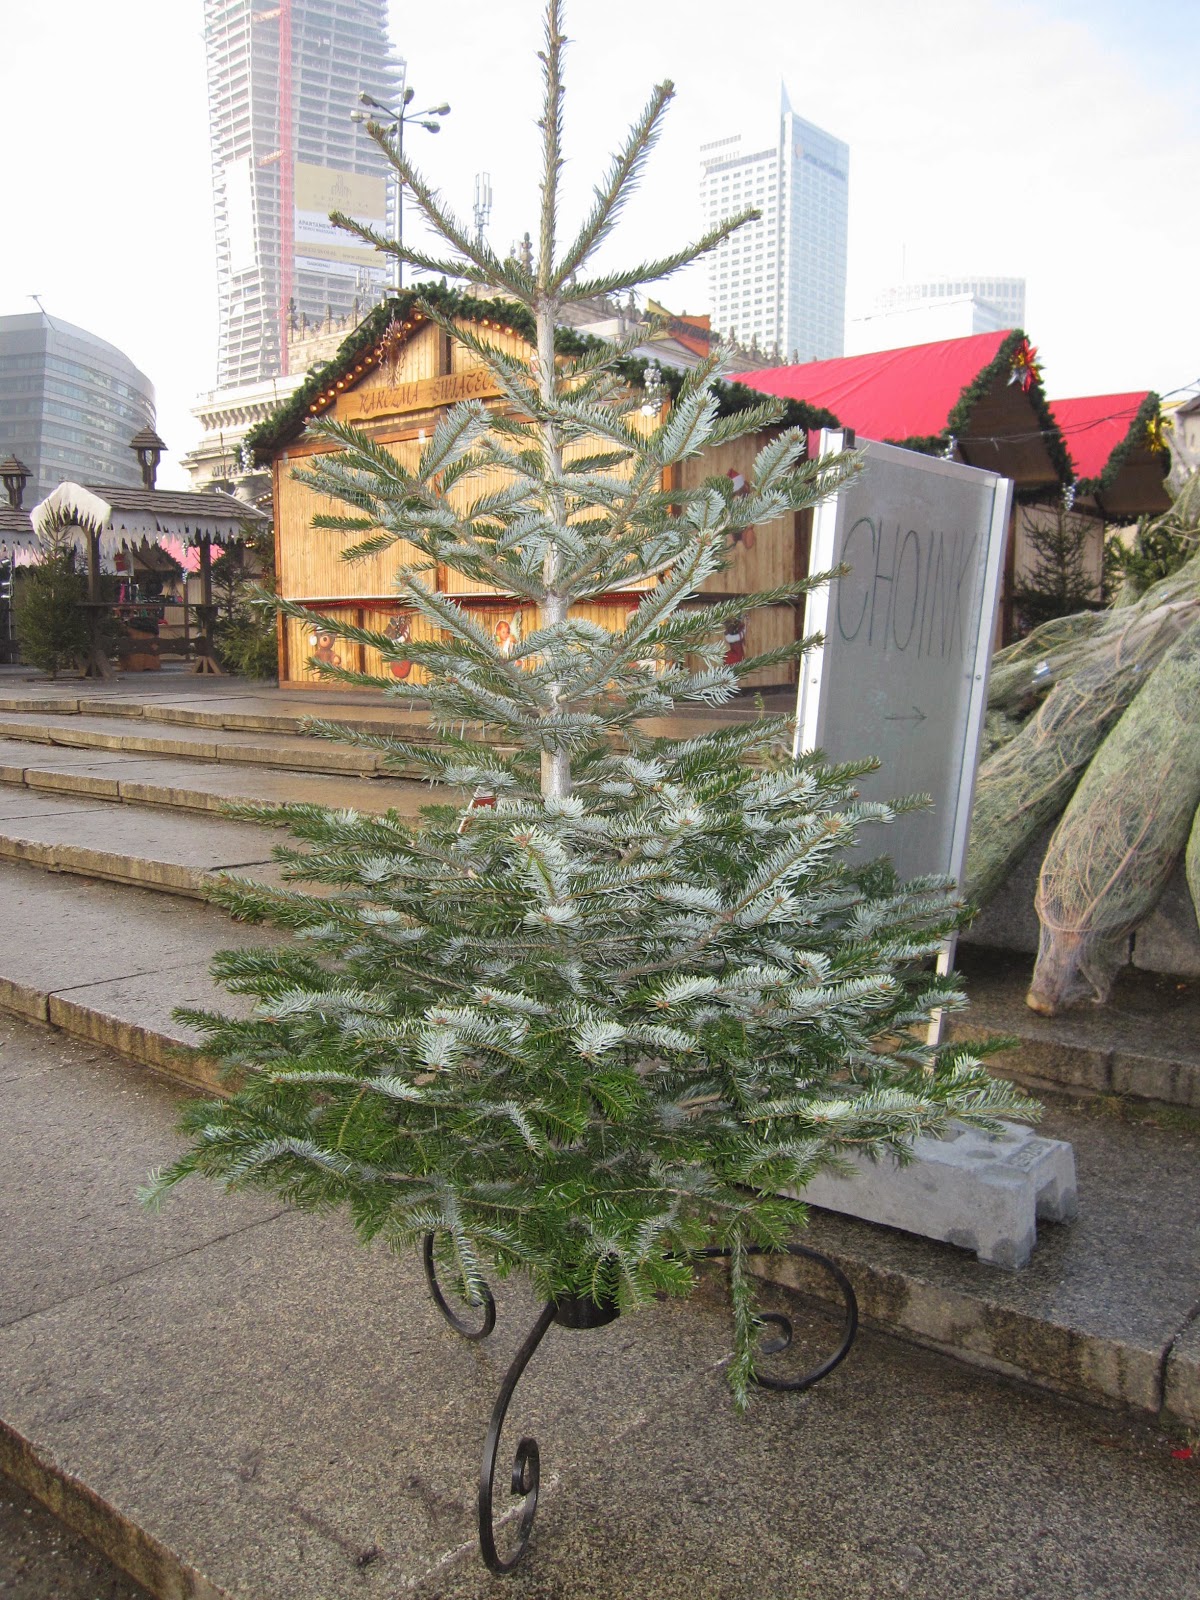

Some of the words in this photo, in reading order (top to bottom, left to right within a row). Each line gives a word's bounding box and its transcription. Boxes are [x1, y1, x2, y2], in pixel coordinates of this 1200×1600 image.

[359, 383, 419, 415] KARCZMA
[212, 462, 246, 478] MUZEU
[837, 516, 984, 663] CHOINKI
